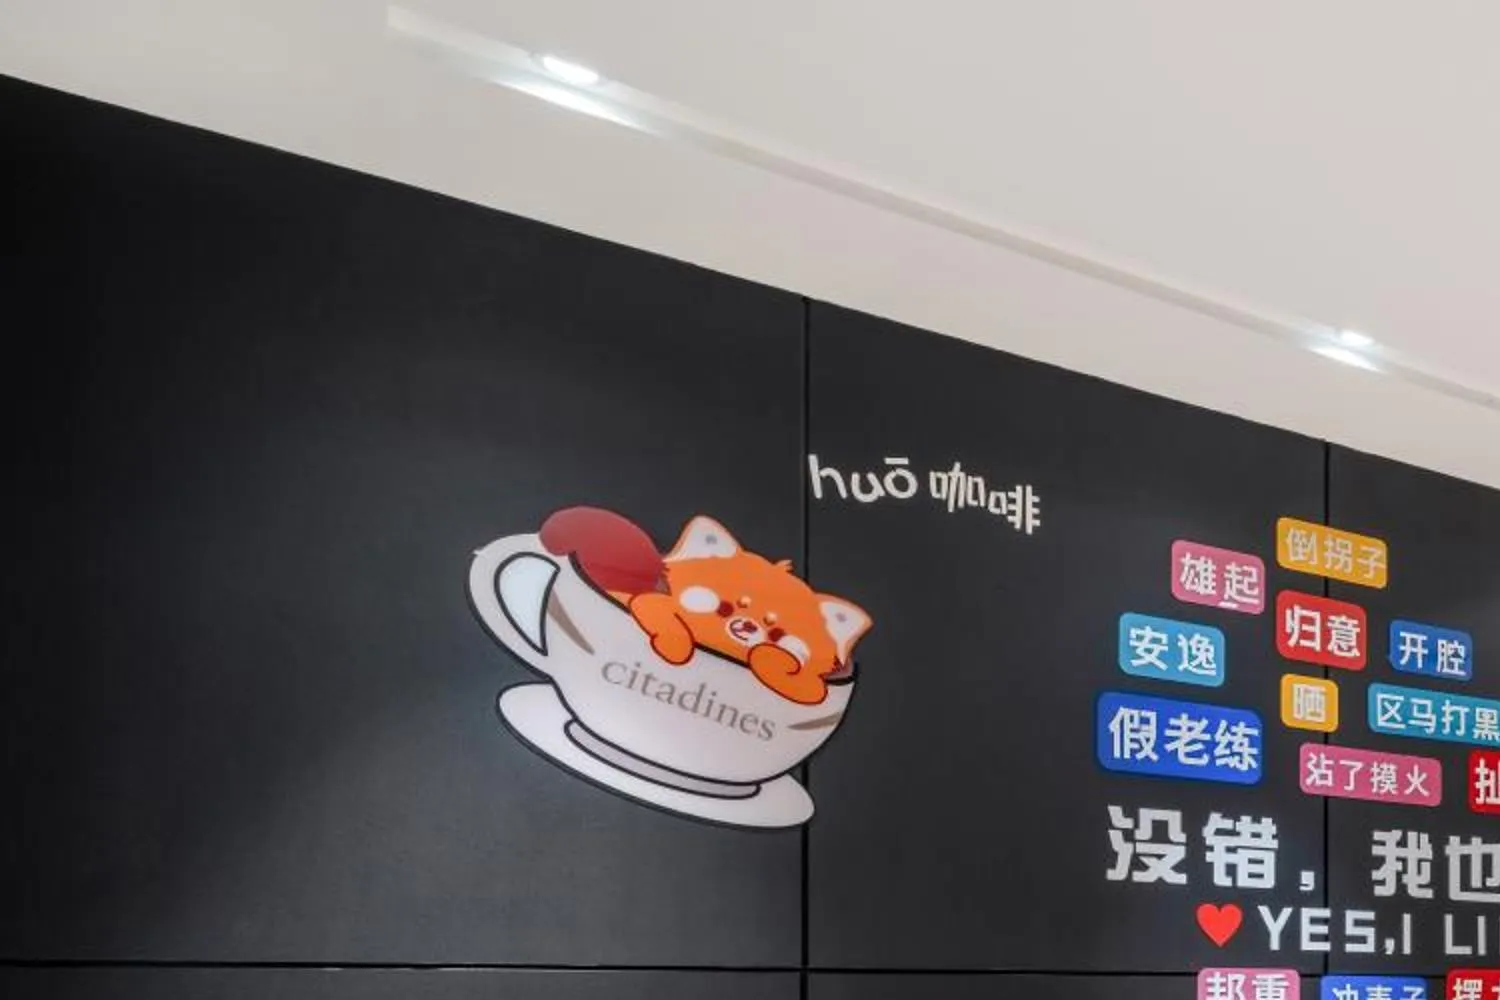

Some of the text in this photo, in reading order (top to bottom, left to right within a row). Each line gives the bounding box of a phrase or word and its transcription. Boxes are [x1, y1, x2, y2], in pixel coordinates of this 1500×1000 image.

[930, 462, 1040, 534] 咖啡
[1286, 529, 1385, 577] 倒拐子
[1180, 552, 1260, 609] 雄起
[1130, 626, 1216, 675] 安逸
[1286, 606, 1360, 657] 归意
[1400, 632, 1466, 675] 开腔
[601, 658, 777, 741] citadines
[1377, 693, 1500, 740] 区马打黑
[1109, 707, 1258, 770] 假老练
